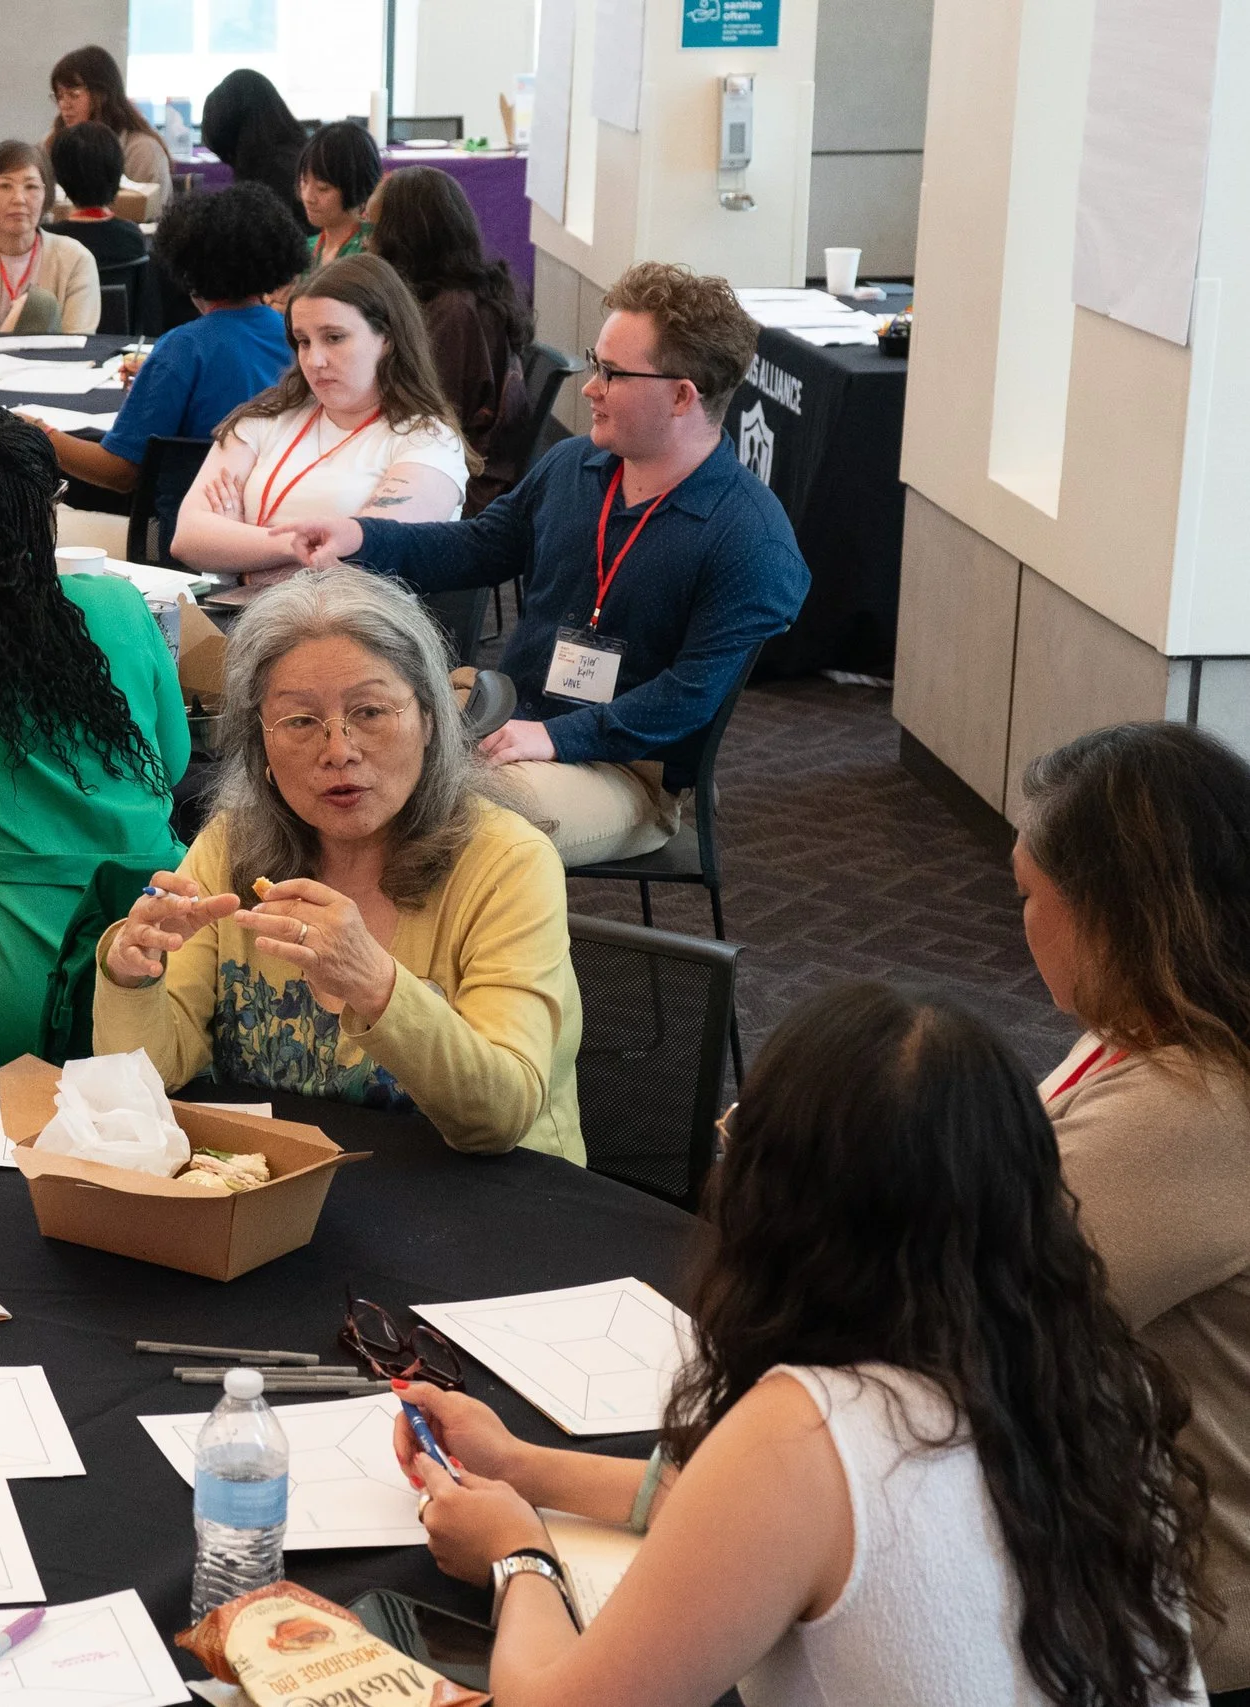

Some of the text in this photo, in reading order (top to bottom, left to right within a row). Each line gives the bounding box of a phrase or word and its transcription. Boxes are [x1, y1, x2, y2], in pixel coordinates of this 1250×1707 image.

[723, 11, 750, 21] often
[758, 358, 803, 416] ALLIANCE
[579, 655, 600, 667] Tyler
[300, 1642, 390, 1682] SMOKEHOUSE
[266, 1669, 299, 1695] BBQ
[358, 1664, 426, 1699] Miss
